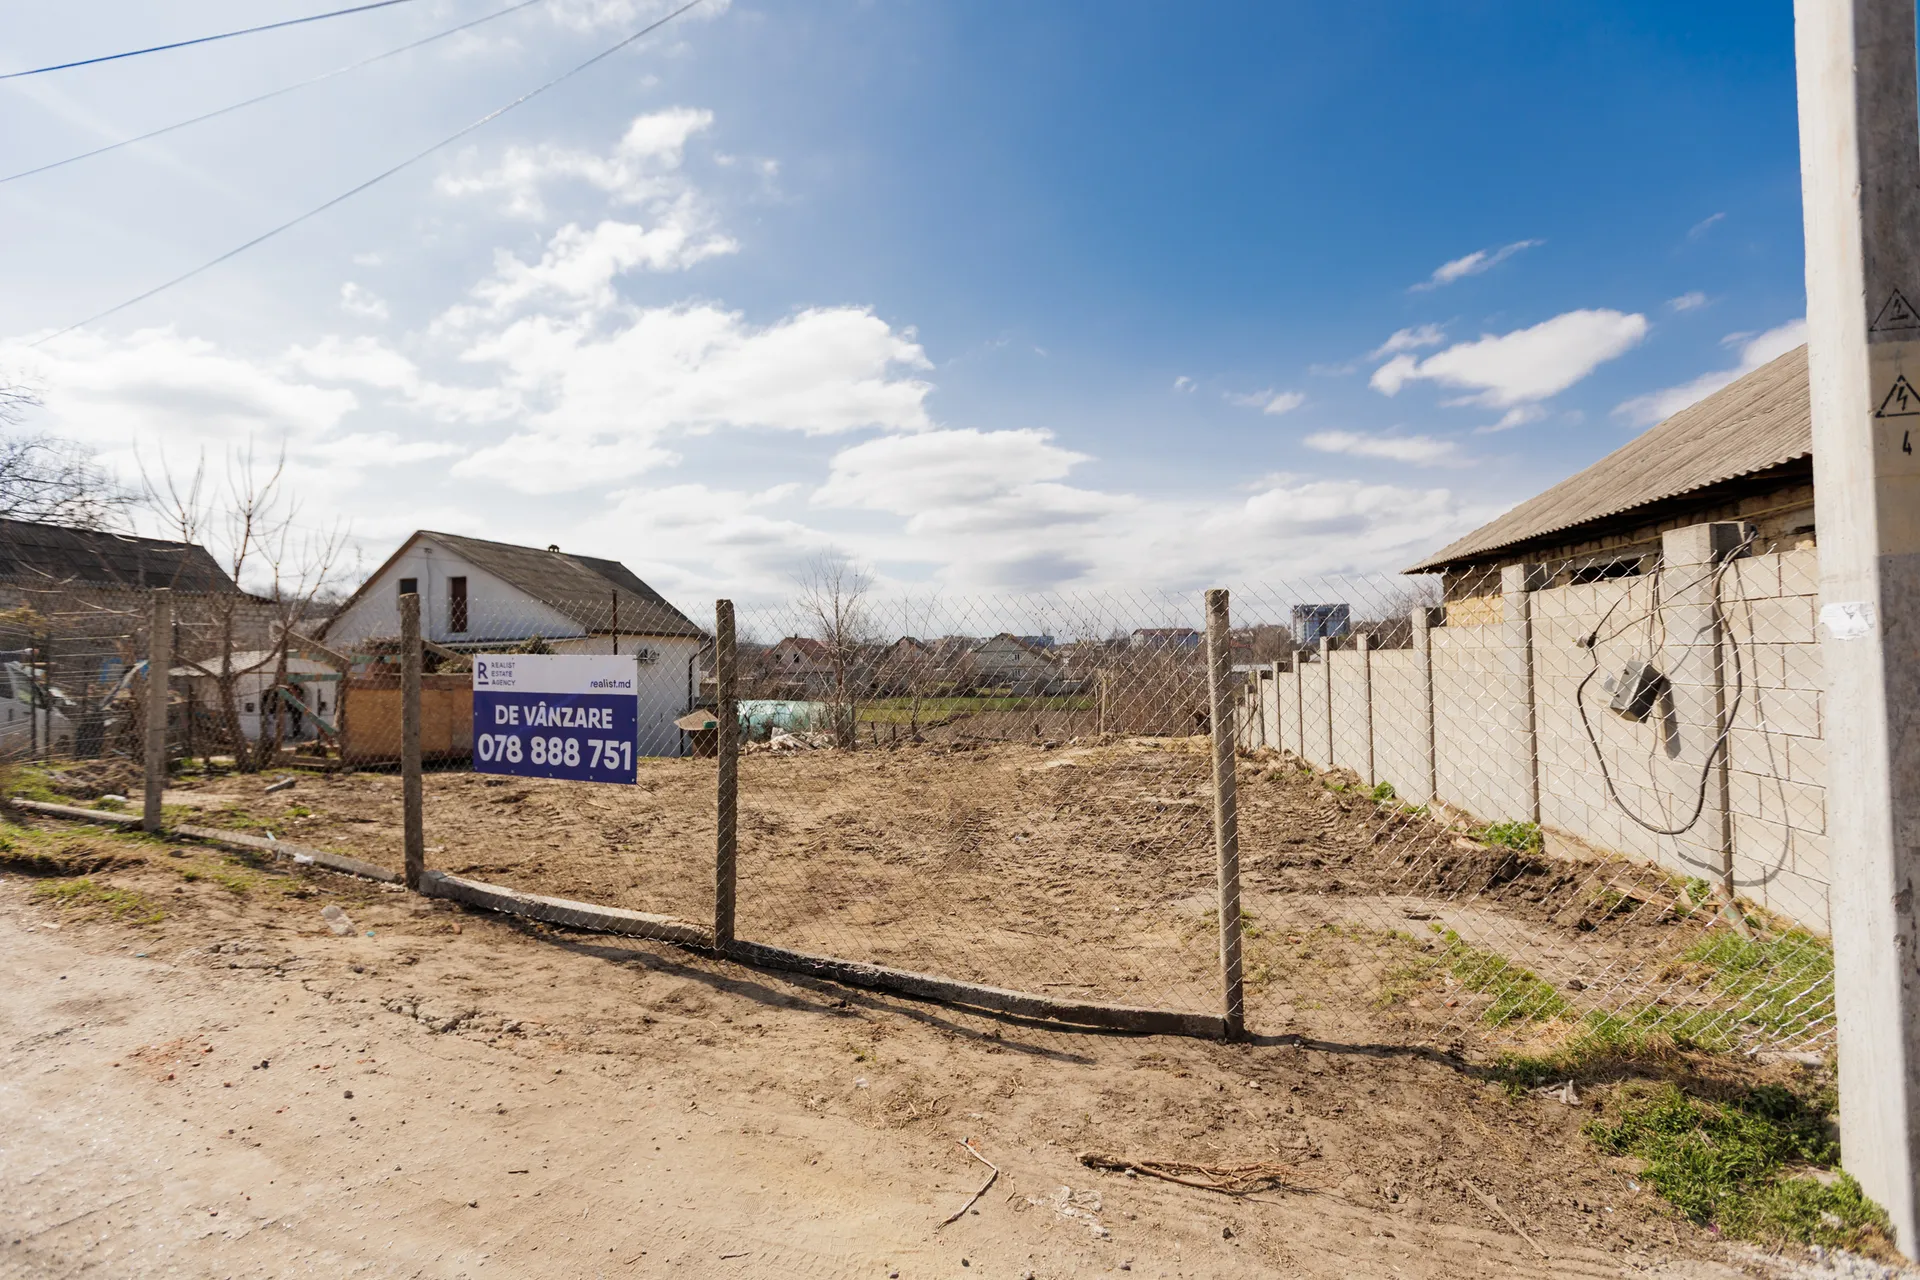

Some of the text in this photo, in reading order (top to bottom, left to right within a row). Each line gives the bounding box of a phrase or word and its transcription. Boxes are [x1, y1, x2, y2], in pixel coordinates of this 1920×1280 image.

[1902, 430, 1913, 456] 4
[478, 662, 488, 679] R
[590, 679, 631, 688] realist.md
[495, 701, 613, 729] DE VÂNZARE
[478, 733, 632, 771] 078 888 751
